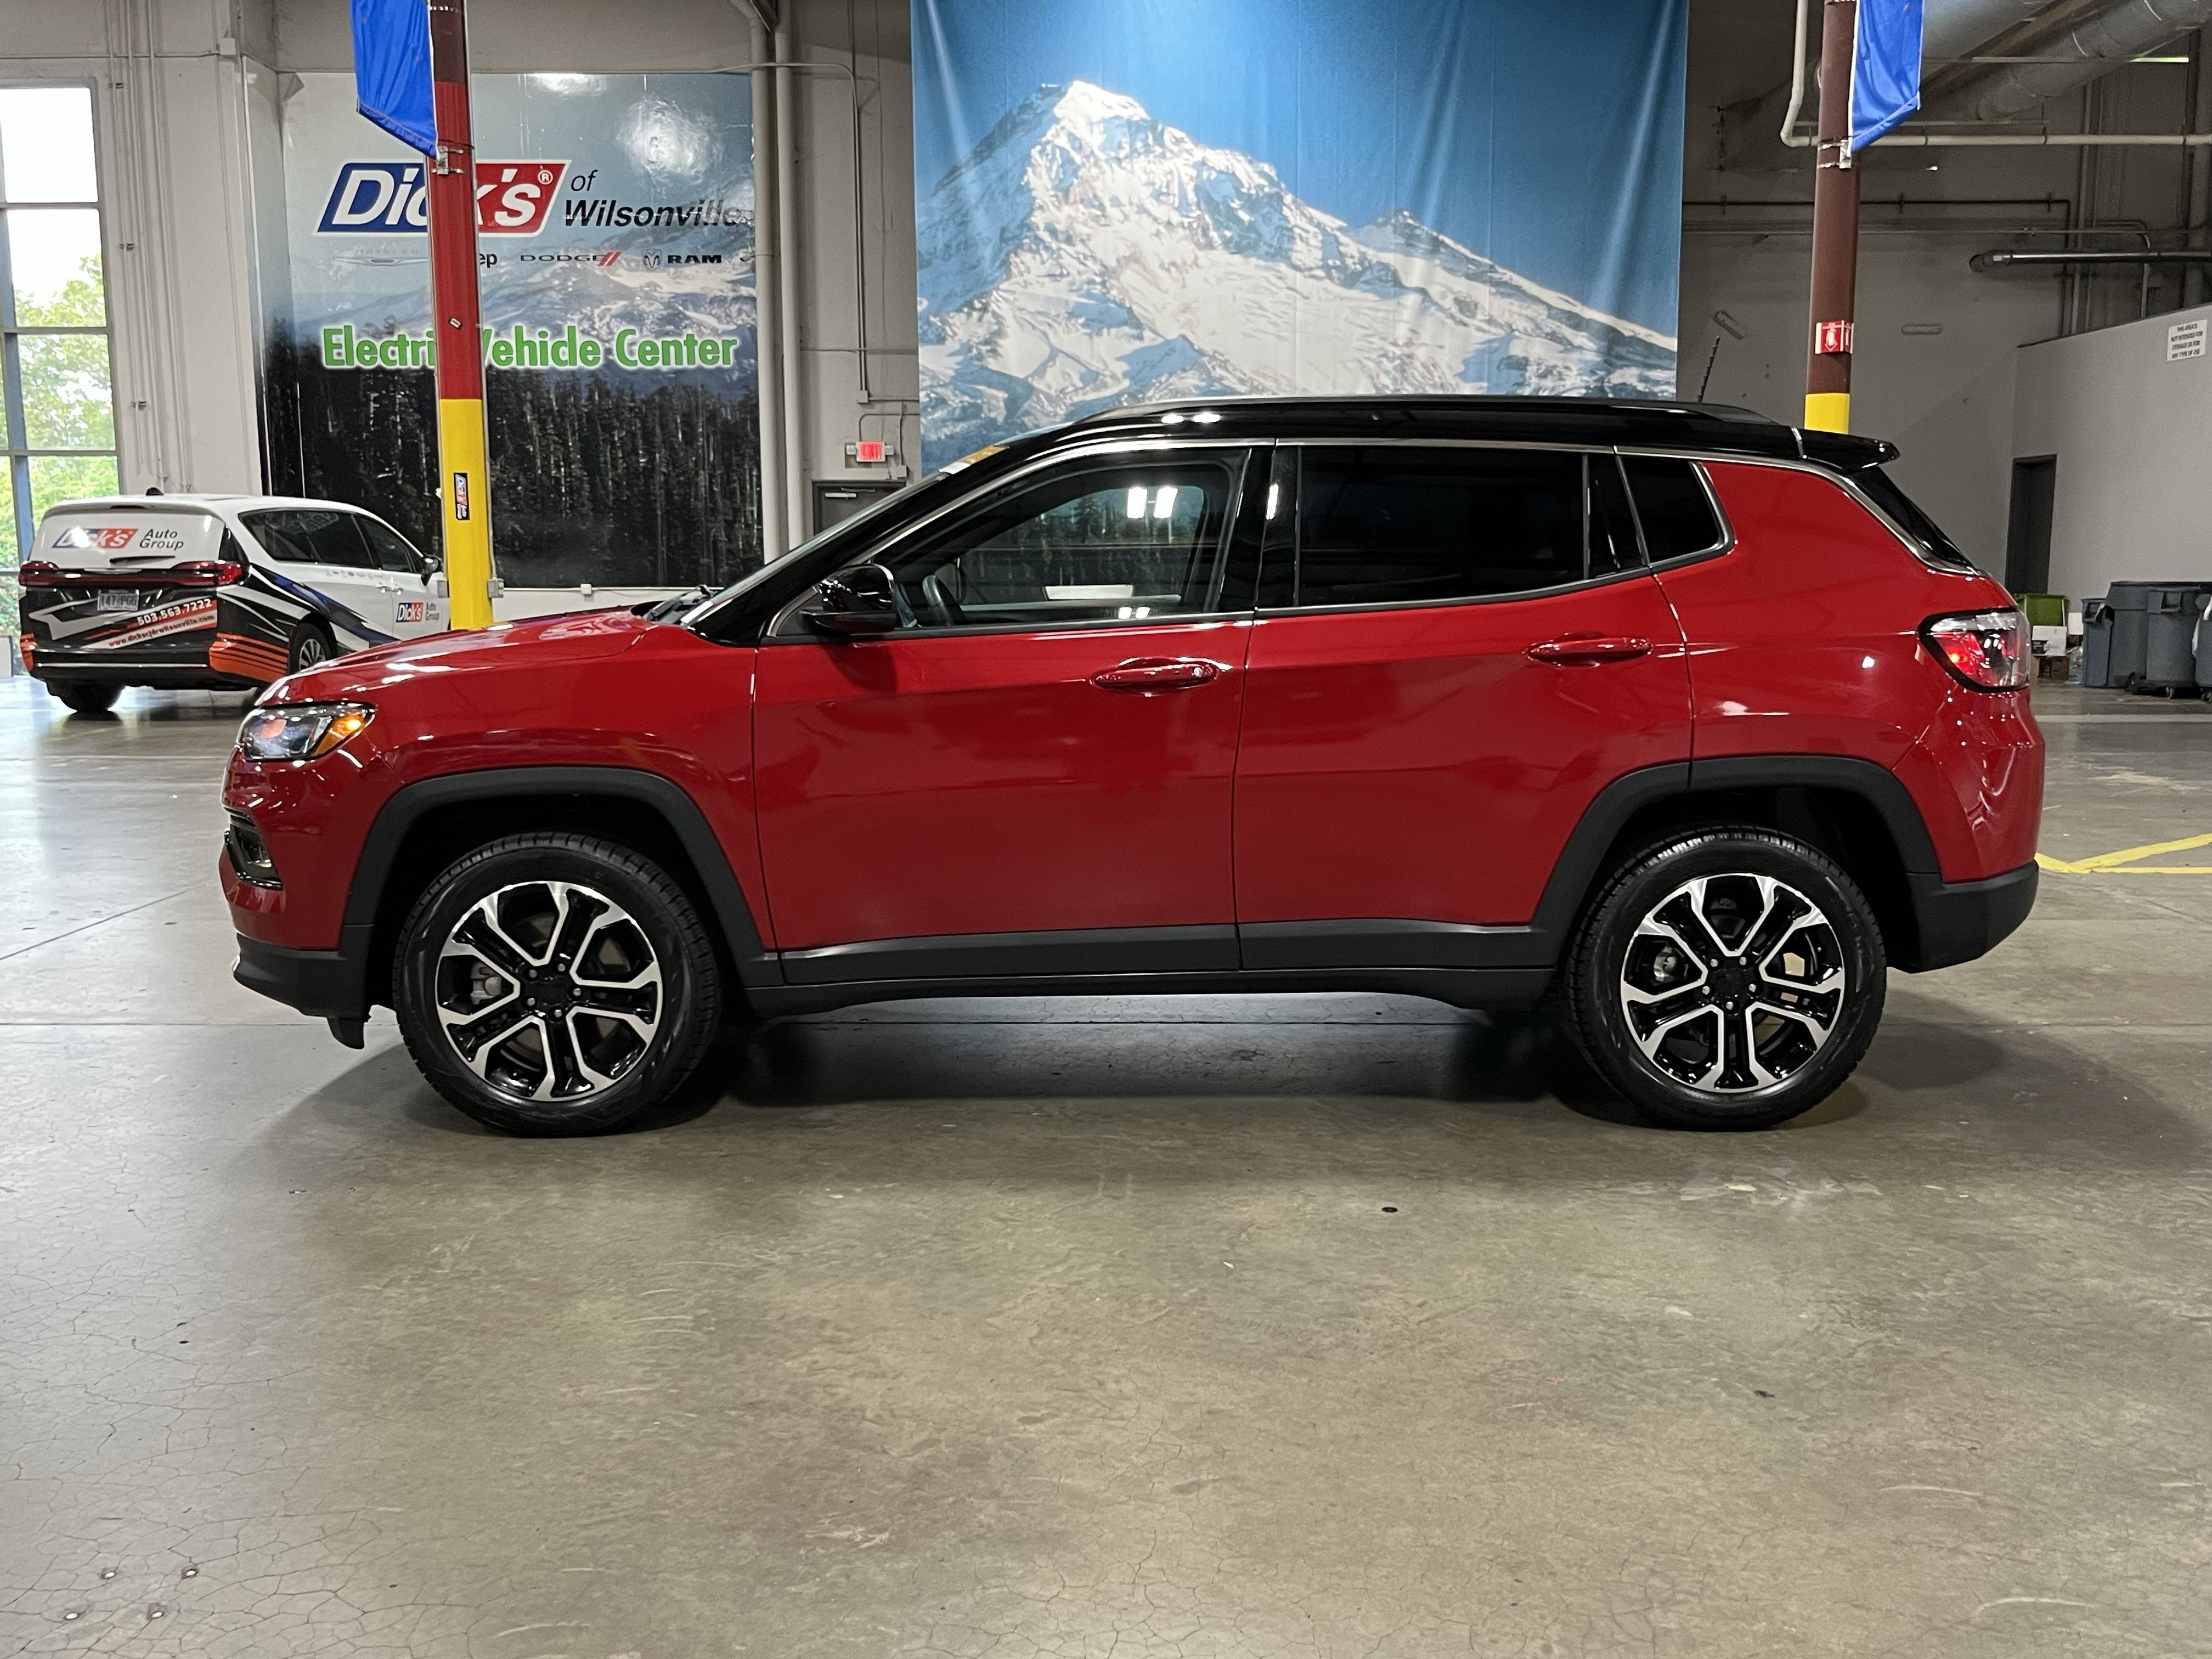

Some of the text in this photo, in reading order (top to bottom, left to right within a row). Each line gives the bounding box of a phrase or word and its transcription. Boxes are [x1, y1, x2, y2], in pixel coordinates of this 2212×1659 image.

[571, 170, 598, 191] of
[479, 253, 498, 268] ep
[667, 255, 722, 264] RAM
[323, 325, 435, 366] Electri
[616, 329, 737, 366] Center
[144, 528, 178, 539] Auto
[139, 538, 184, 551] Group
[137, 599, 213, 626] 503.563.7222
